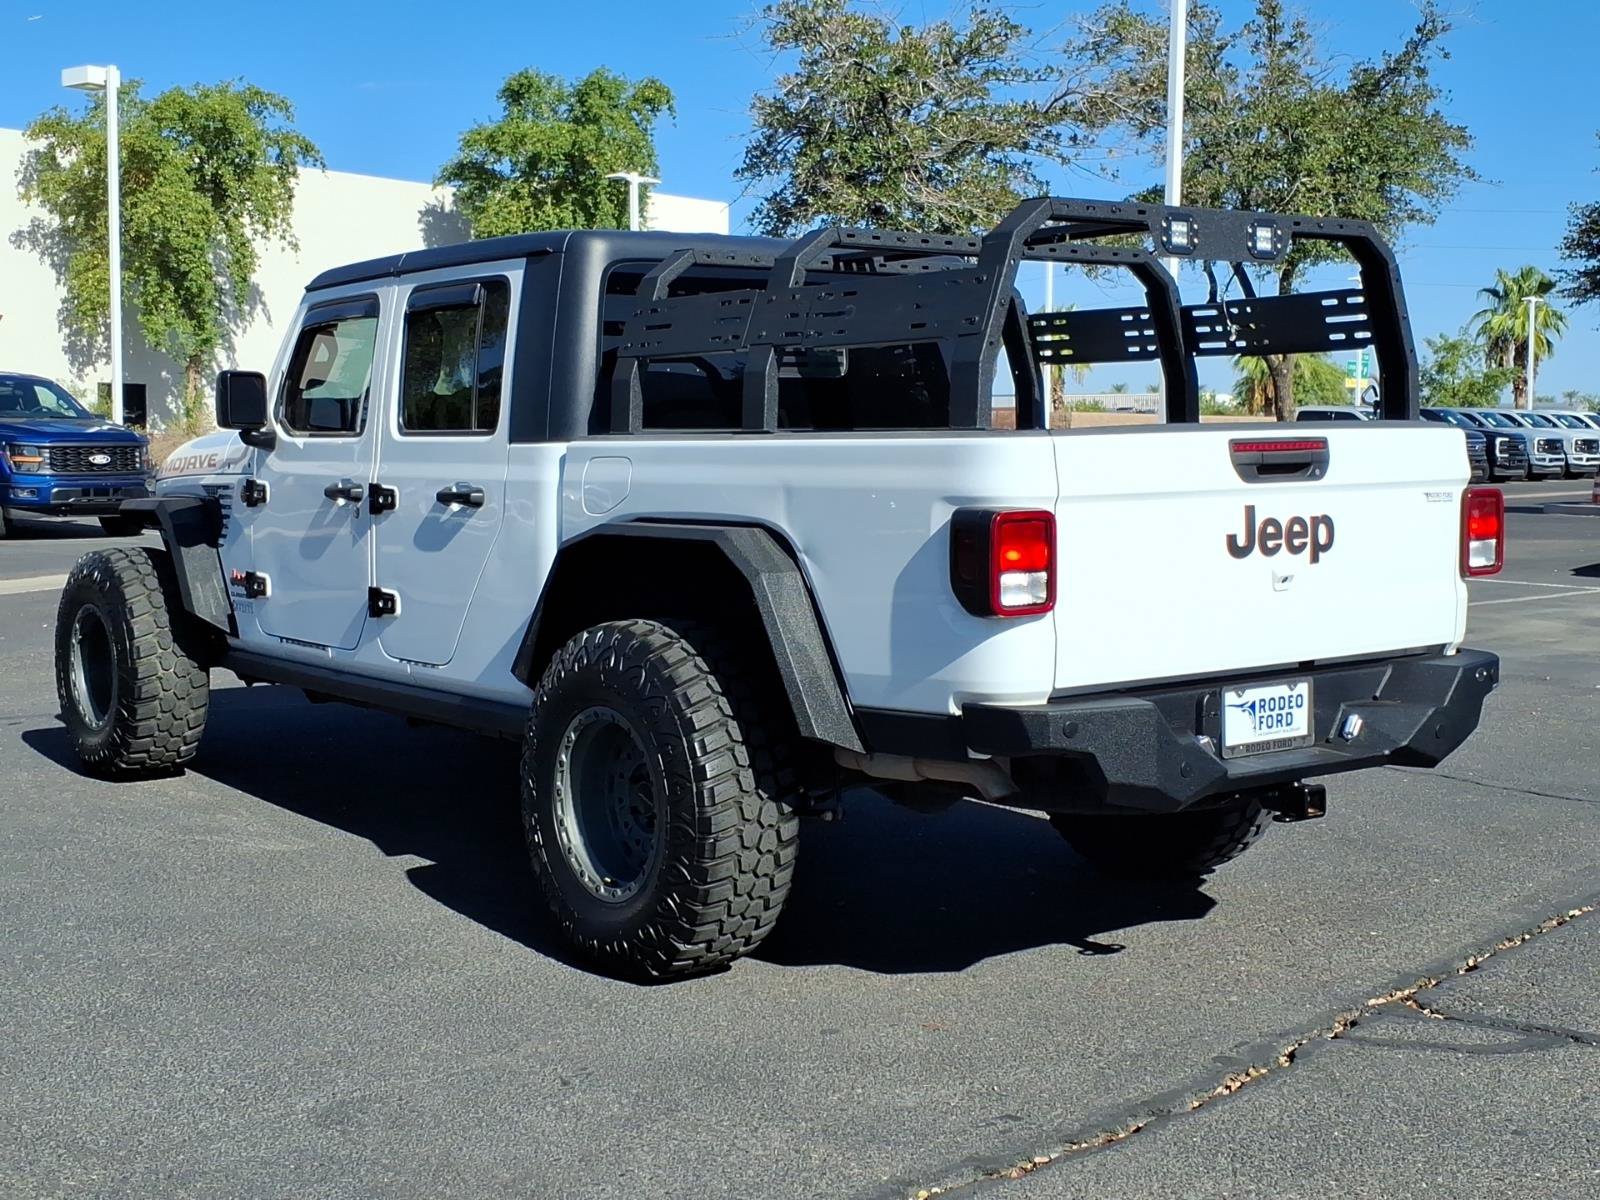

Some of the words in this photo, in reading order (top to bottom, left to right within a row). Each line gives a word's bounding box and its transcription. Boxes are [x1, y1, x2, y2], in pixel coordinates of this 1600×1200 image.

[160, 453, 218, 474] MOJAVE
[1226, 504, 1335, 564] Jeep
[1258, 694, 1304, 714] RODEO
[1258, 712, 1294, 731] FORD
